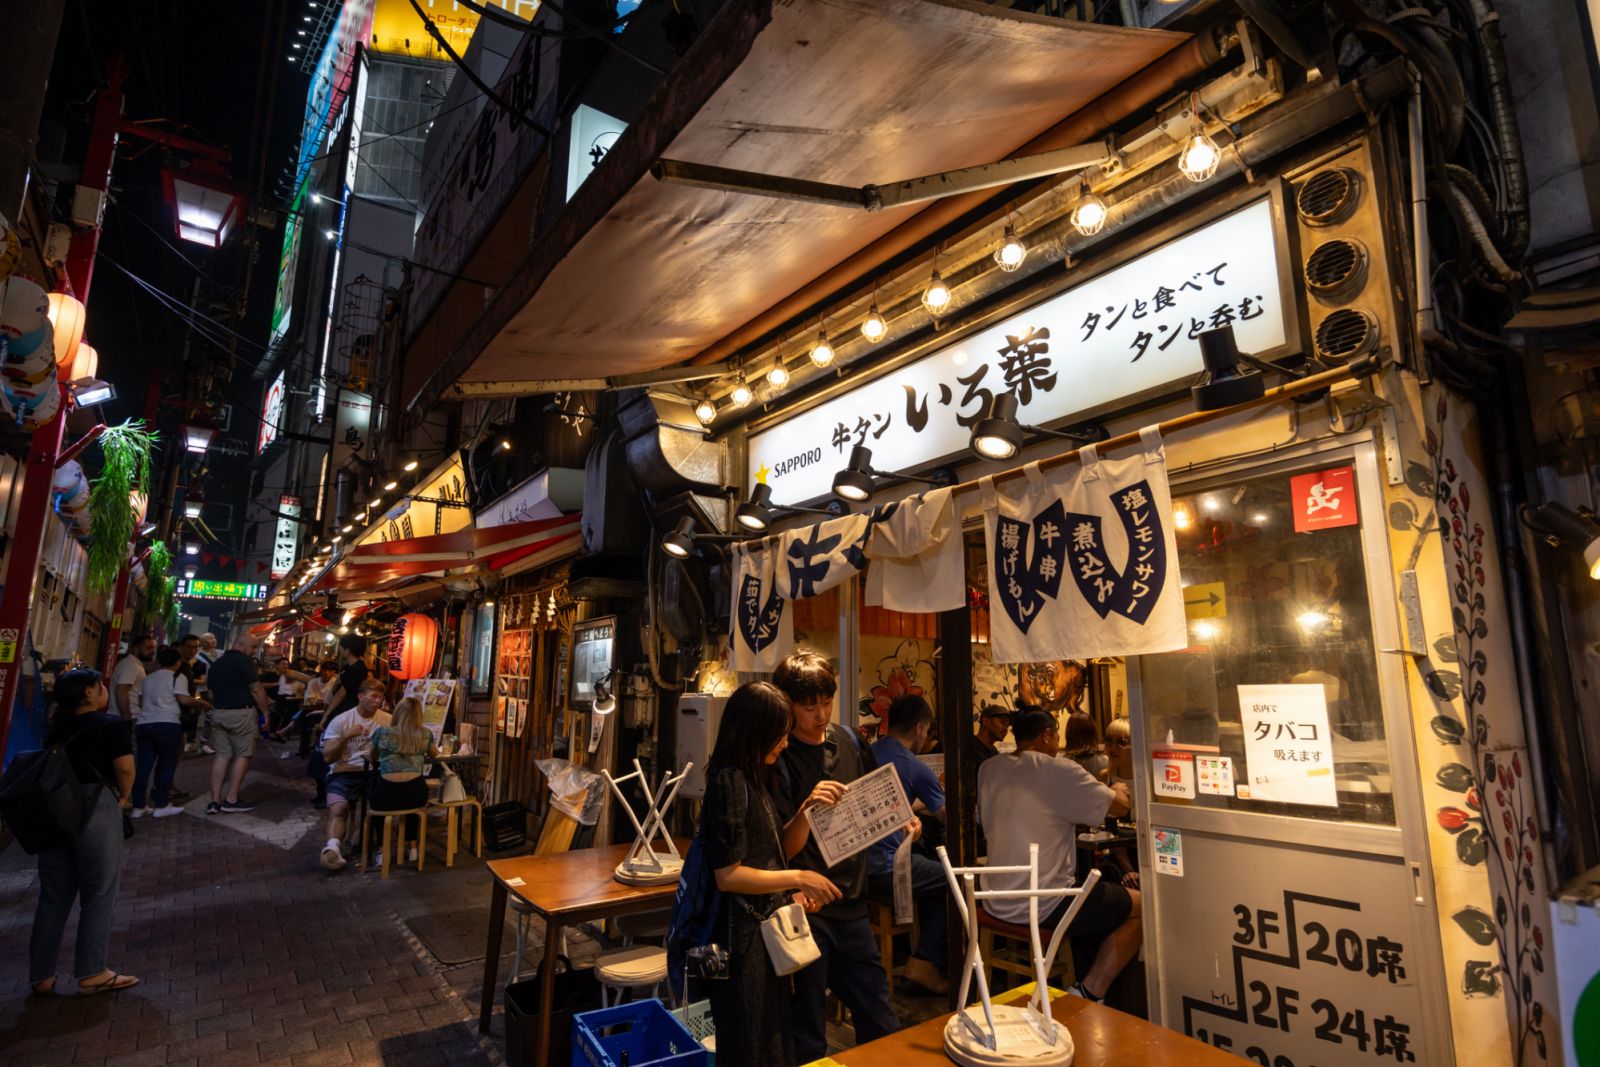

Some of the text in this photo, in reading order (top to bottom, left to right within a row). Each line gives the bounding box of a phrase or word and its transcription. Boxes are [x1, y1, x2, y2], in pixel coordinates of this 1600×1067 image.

[1080, 262, 1229, 342] タンと食べて
[1129, 296, 1264, 363] タンと呑む
[832, 327, 1058, 454] 牛タン いろ葉
[774, 447, 821, 478] SAPPORO
[1001, 523, 1035, 622] 揚げもん
[1039, 521, 1061, 582] 牛串
[1072, 521, 1115, 603] 煮込み
[1121, 488, 1155, 614] 塩レモンサワー
[1252, 704, 1278, 714] 店内で
[1254, 720, 1319, 741] タバコ
[1274, 749, 1323, 763] 吸えます
[1162, 783, 1186, 792] PayPay
[1233, 904, 1279, 949] 3F
[1303, 921, 1407, 983] 20席
[1249, 980, 1300, 1033] 2F
[1311, 998, 1416, 1063] 24席
